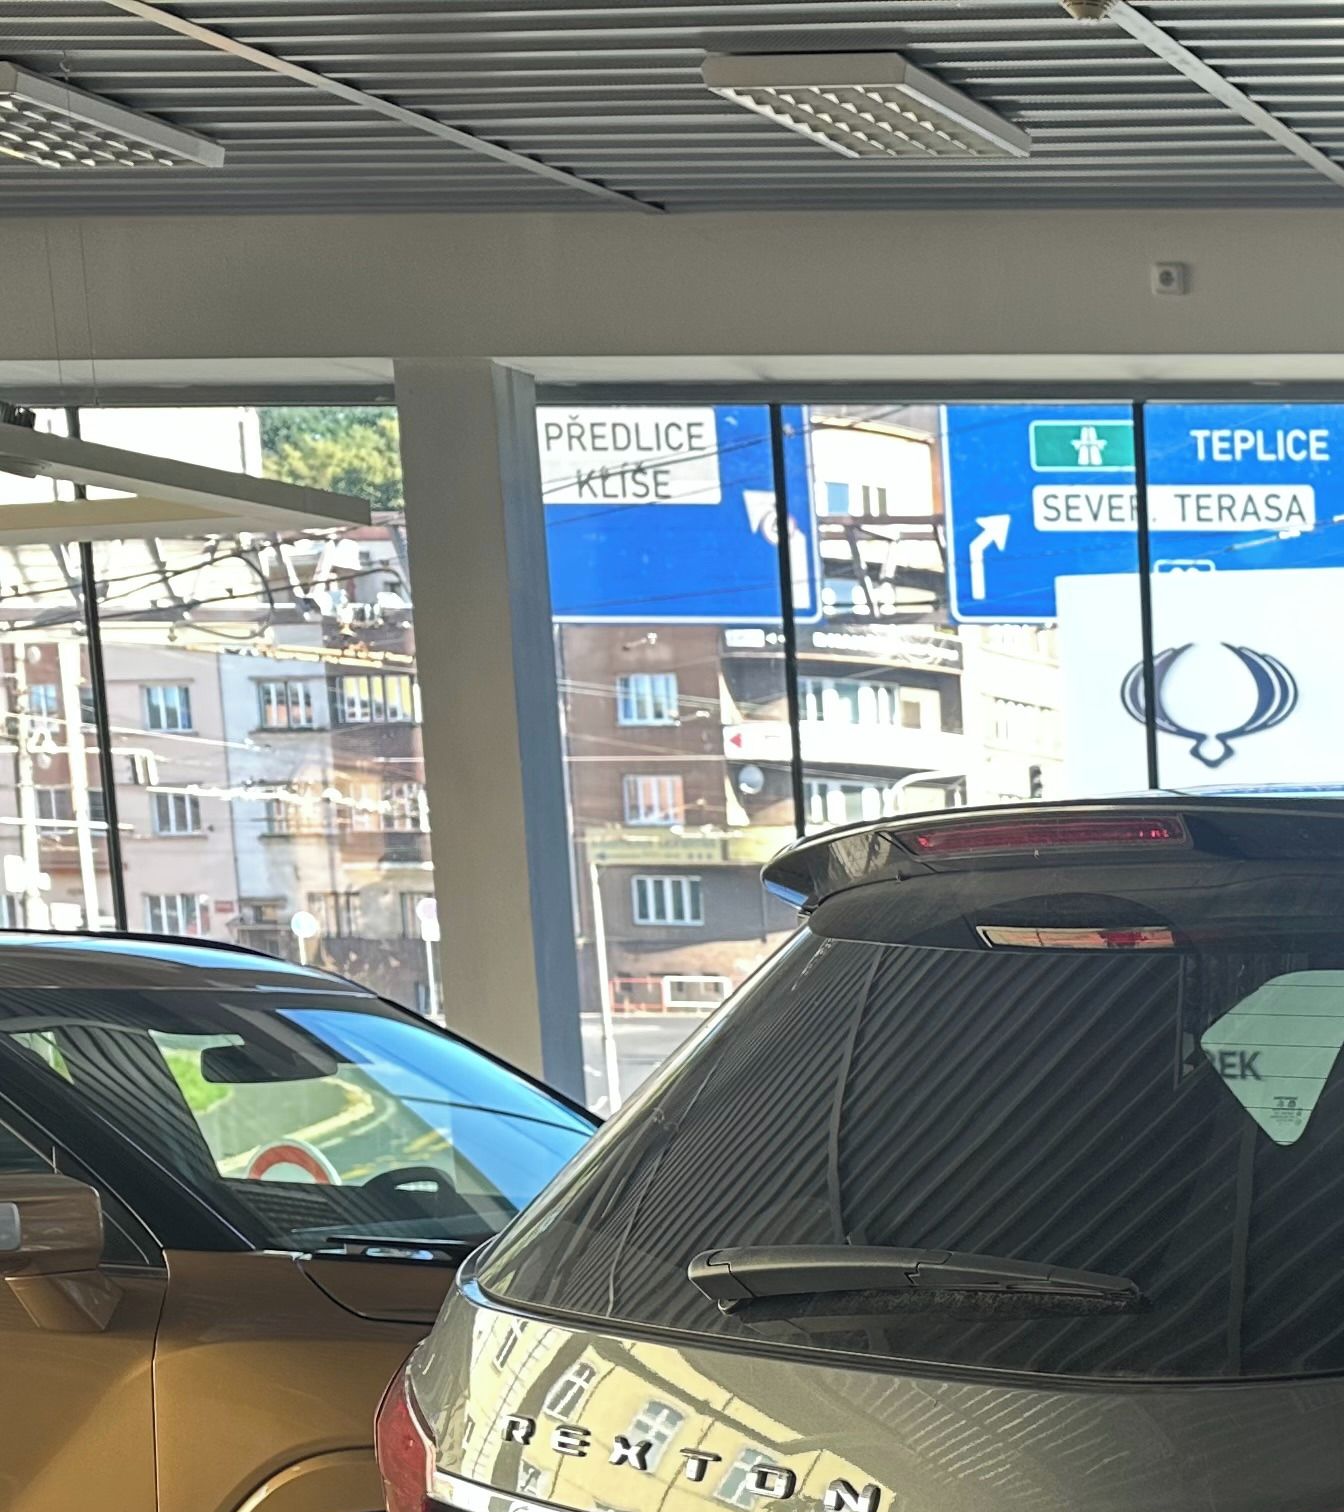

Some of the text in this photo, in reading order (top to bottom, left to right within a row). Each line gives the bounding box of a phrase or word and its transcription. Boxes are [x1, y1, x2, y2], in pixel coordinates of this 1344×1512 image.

[544, 415, 706, 451] PŘEDLICE
[1189, 428, 1331, 461] TEPLICE
[576, 461, 672, 499] KLÍŠE
[1173, 493, 1307, 523] TERASA
